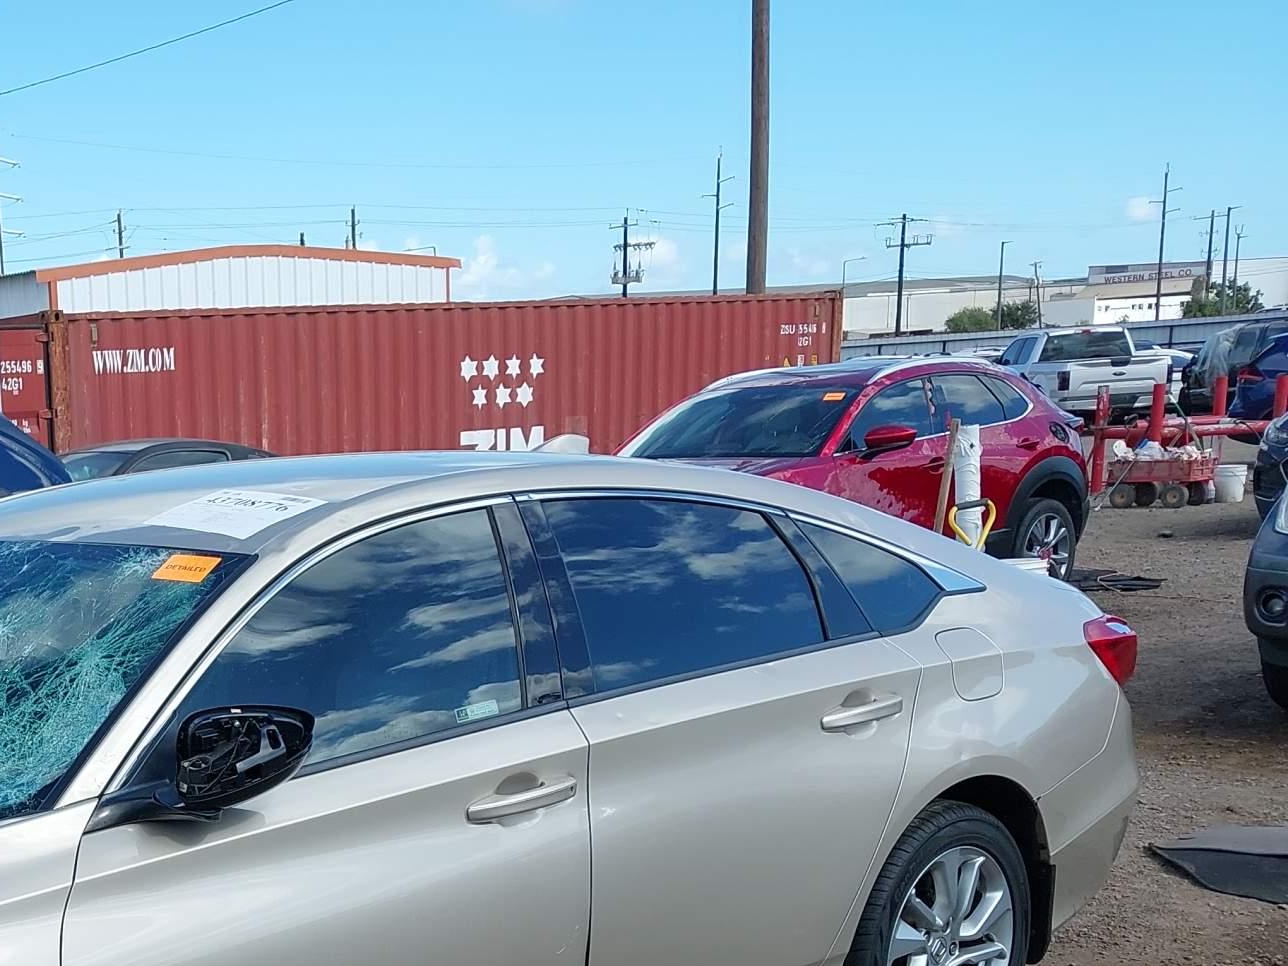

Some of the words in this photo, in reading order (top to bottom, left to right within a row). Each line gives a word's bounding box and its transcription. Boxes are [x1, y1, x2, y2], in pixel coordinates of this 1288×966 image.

[1104, 272, 1145, 285] WESTERN
[0, 359, 32, 374] 255496
[1, 377, 23, 390] 42G1
[165, 564, 207, 573] DETAILED
